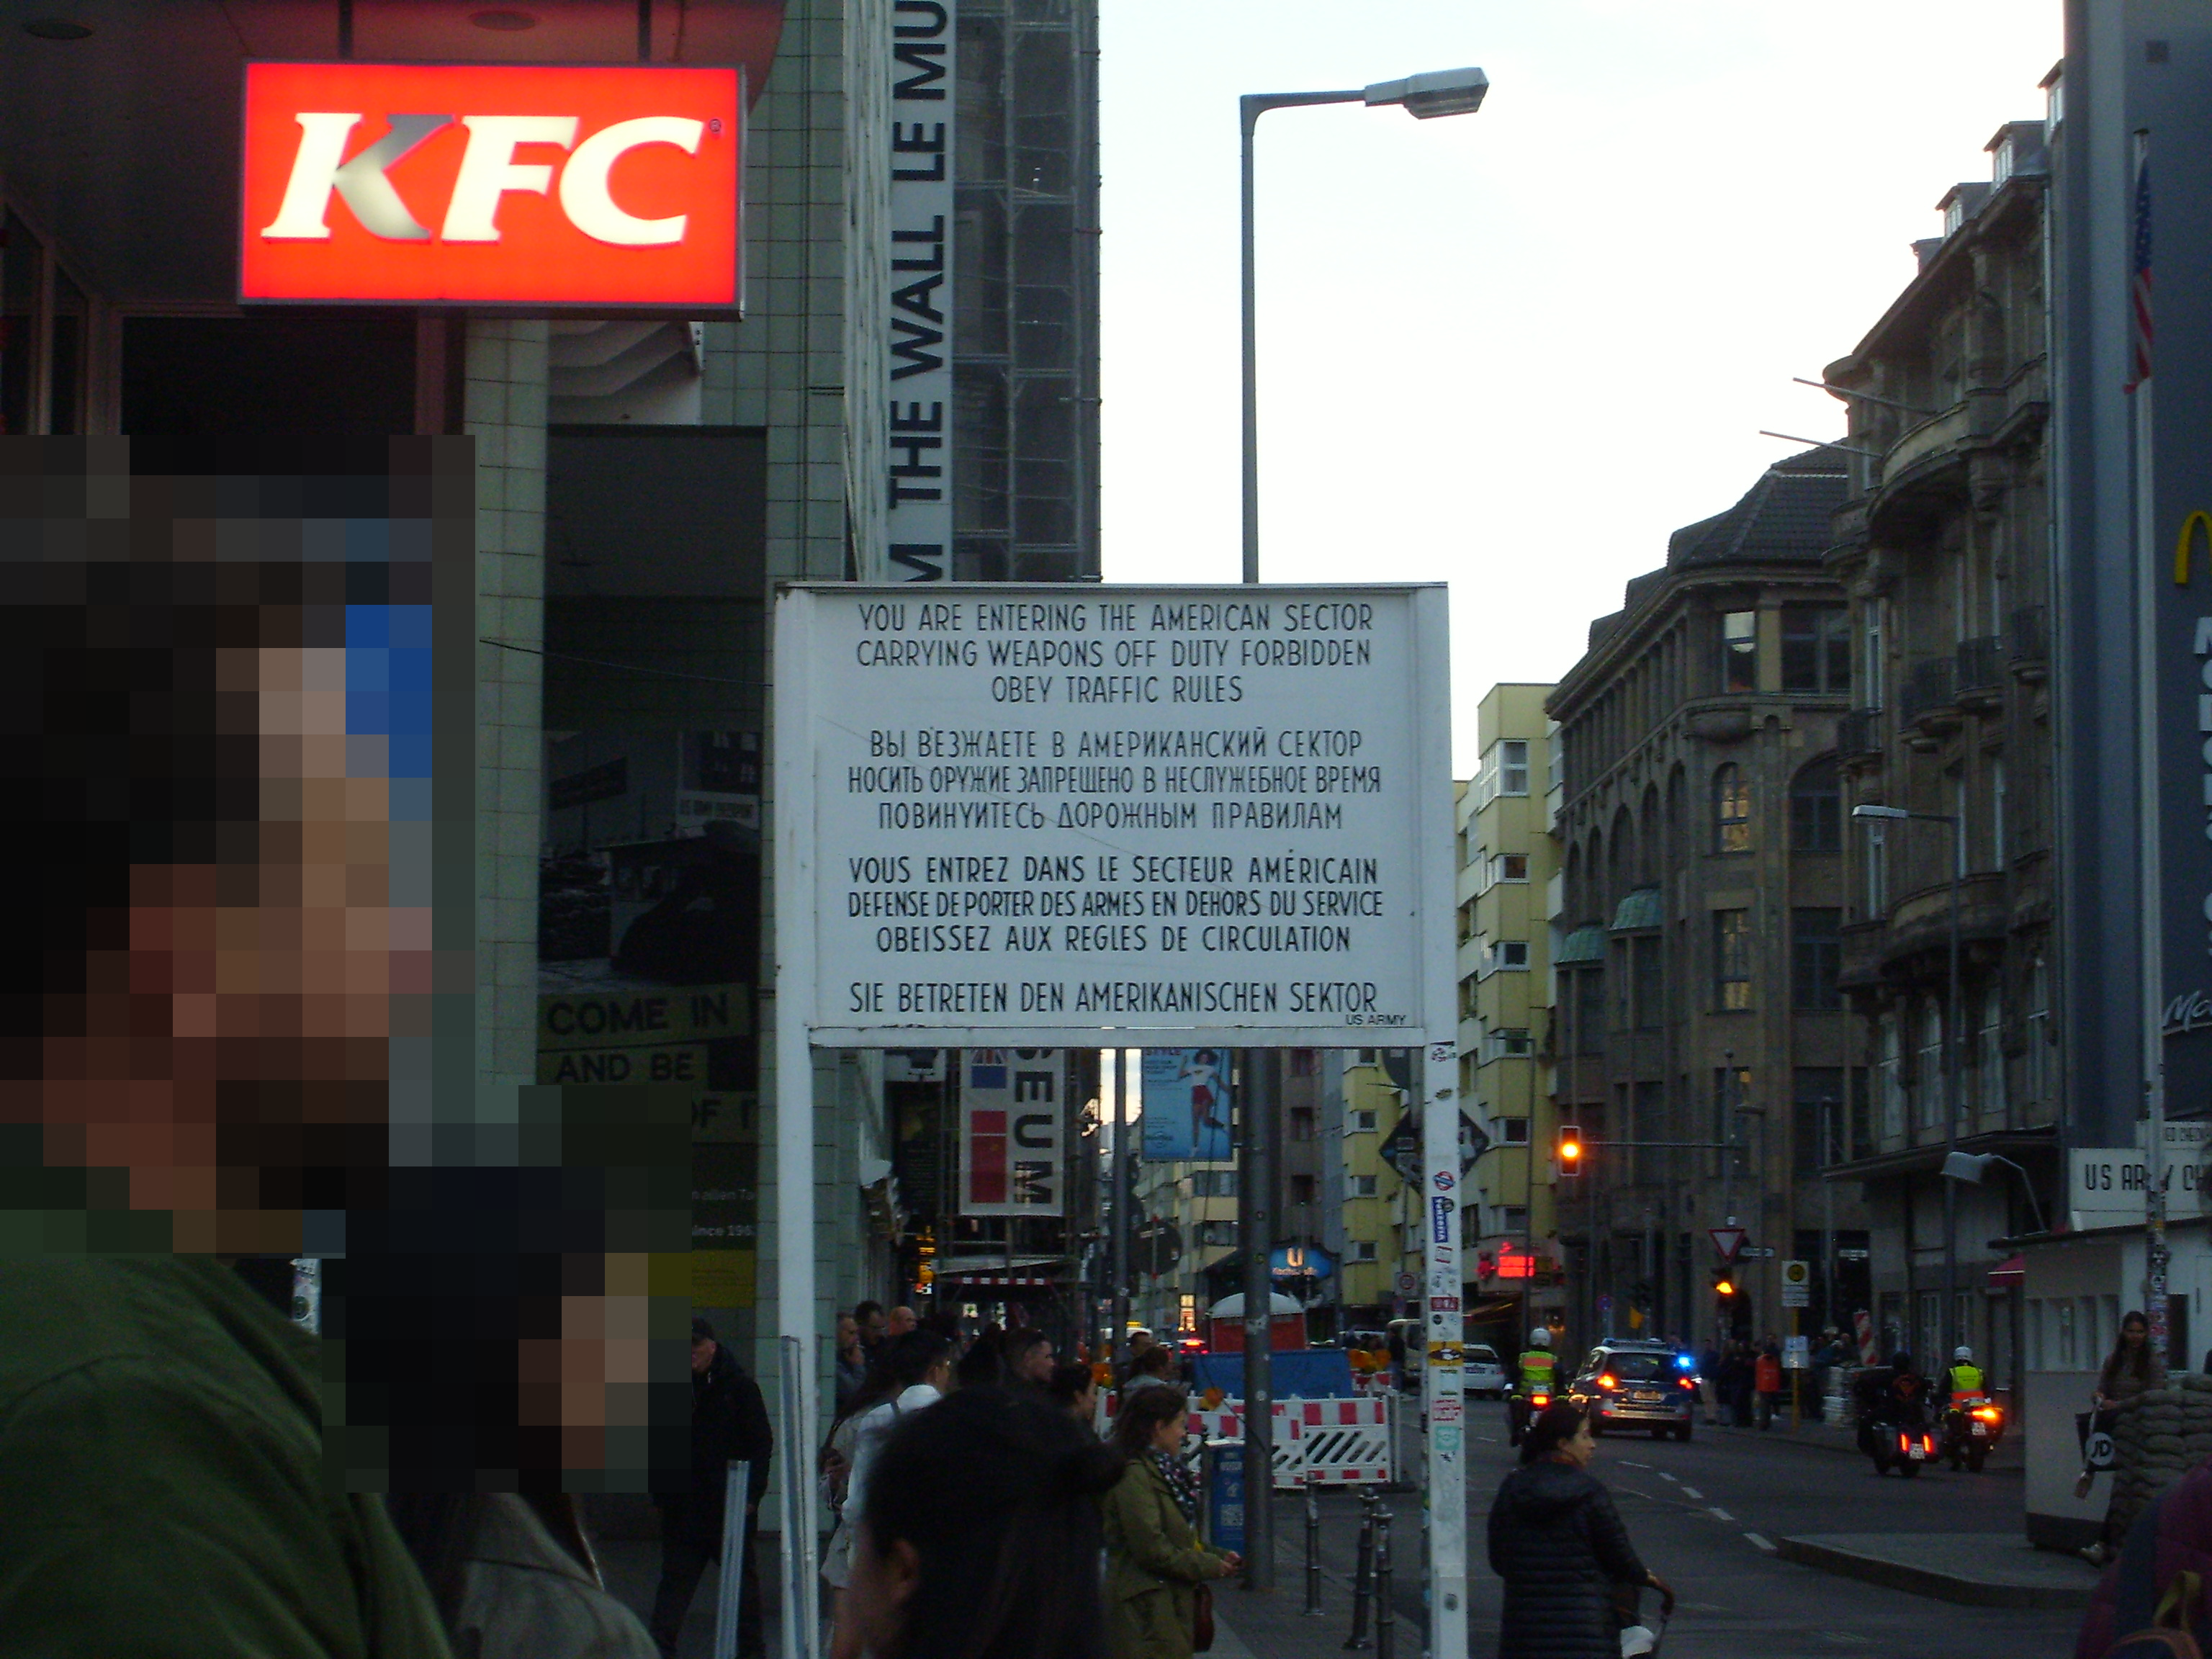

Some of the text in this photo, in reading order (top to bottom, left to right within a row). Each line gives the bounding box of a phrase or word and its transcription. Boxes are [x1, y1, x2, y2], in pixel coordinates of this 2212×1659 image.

[892, 121, 945, 181] LE
[261, 112, 705, 246] KFC
[891, 215, 944, 381] WALL
[889, 400, 943, 509] THE
[858, 603, 1375, 632] YOU ARE ENTERING THE AMERICAN SECTOR
[856, 639, 1370, 668] CARRYING WEAPONS OFF DUTY FORBIDDEN
[992, 675, 1243, 703] OBEY TRAFFIC RULES
[870, 729, 906, 758] ВЫ
[1052, 730, 1065, 758] В
[1078, 726, 1267, 758] АМЕРИКАНСКИЙ
[1277, 729, 1362, 757] СЕКТОР
[848, 765, 924, 793] НОСИТЬ
[929, 765, 1011, 793] ОРУЖИЕ
[1143, 765, 1157, 793] В
[1165, 765, 1308, 793] НЕСЛУЖЕБНОЕ
[1316, 765, 1381, 793] ВРЕМЯ
[1056, 801, 1197, 829] ДОРОЖНЫМ
[1212, 801, 1341, 830] ПРАВИЛАМ
[848, 848, 1377, 884] VOUS ENTREZ DANS LE SECTEUR AMÉRICAIN
[848, 889, 1383, 918] DEFENSE DE PORTER DES ARMES EN DEHORS DU SERVICE
[876, 924, 1350, 953] OBEISSEZ AUX REGLES DE CIRCULATION
[850, 981, 1377, 1013] SIE BETRETEN DEN AMERIKANISCHEN SEKTOR
[547, 993, 729, 1035] COME IN
[1346, 1014, 1406, 1025] US ARMY
[555, 1052, 696, 1083] AND BE
[2085, 1164, 2111, 1190] US
[1287, 1247, 1304, 1267] U
[2091, 1439, 2110, 1457] JD
